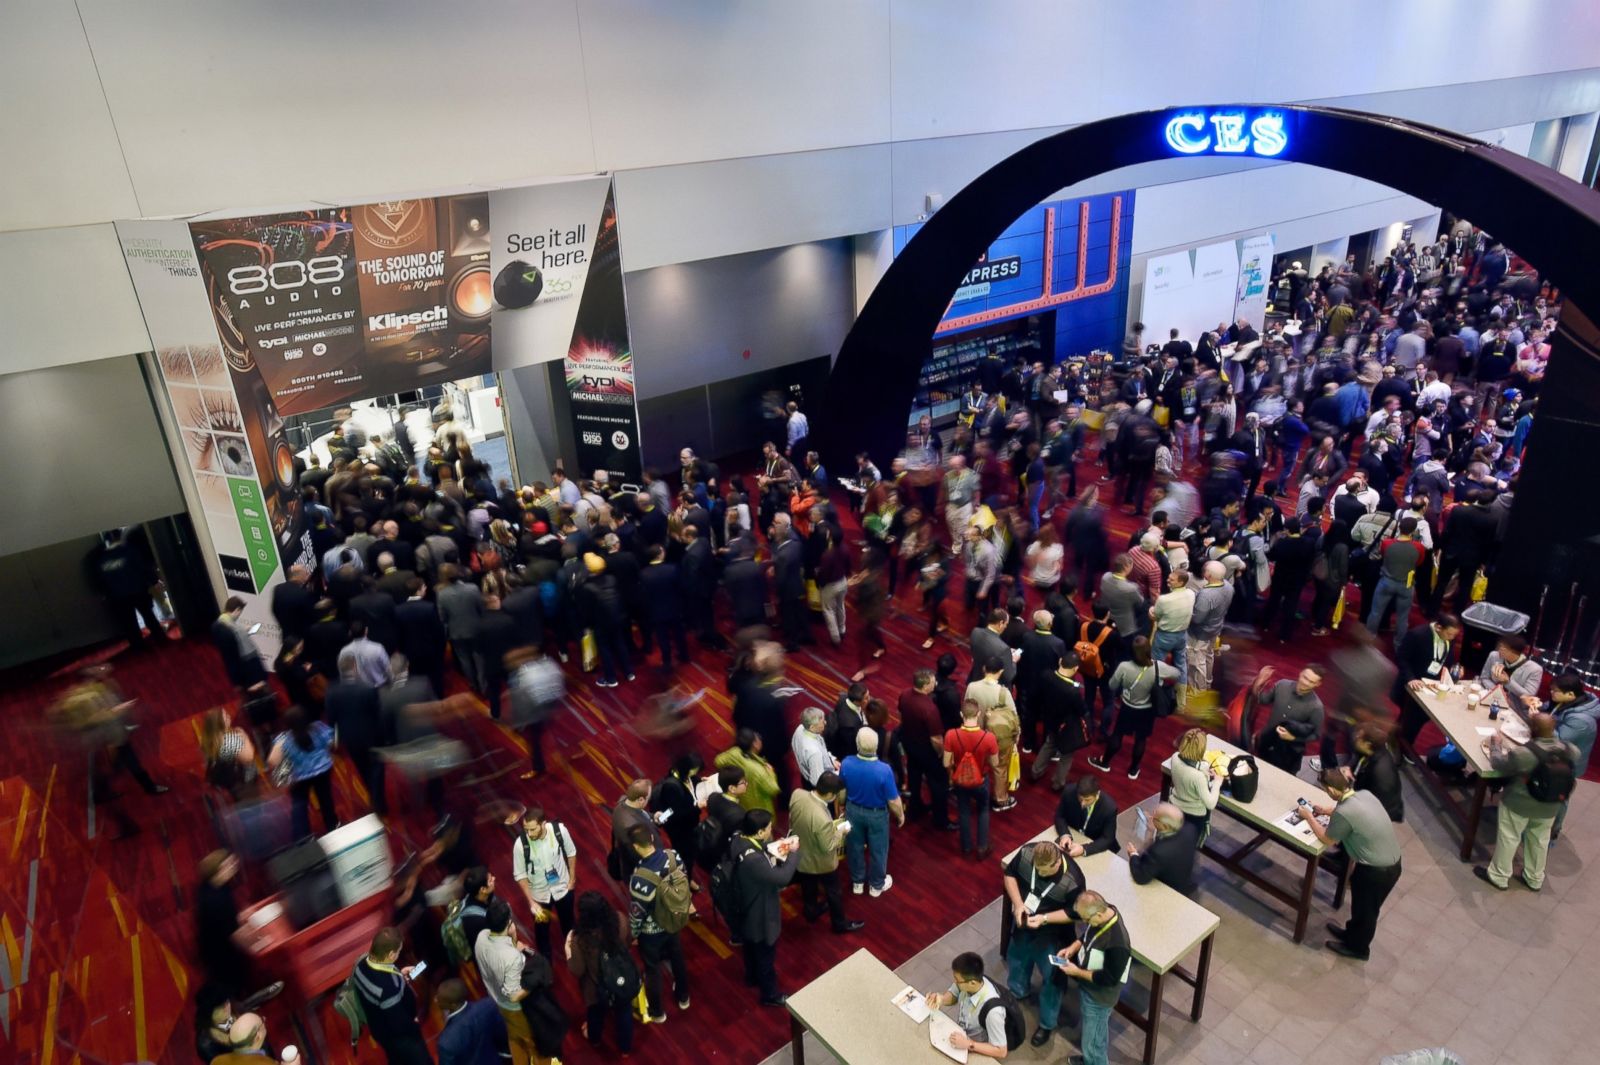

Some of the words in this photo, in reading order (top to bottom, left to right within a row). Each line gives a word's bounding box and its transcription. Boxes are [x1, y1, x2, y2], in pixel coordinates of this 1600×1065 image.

[1165, 112, 1287, 156] CES
[507, 233, 545, 254] See
[549, 228, 562, 248] it
[565, 223, 586, 246] all
[359, 258, 384, 274] THE
[386, 253, 428, 271] SOUND
[429, 250, 445, 264] OF
[541, 249, 587, 270] here.
[167, 267, 198, 277] THINGS
[227, 255, 345, 295] 808
[373, 262, 445, 286] TOMORROW
[961, 261, 1018, 285] XPRESS
[413, 280, 425, 289] 70
[240, 286, 342, 309] AUDIO
[254, 323, 272, 333] LIVE
[273, 311, 343, 330] PERFORMANCES
[344, 310, 356, 319] BY
[288, 308, 323, 318] FEATURING
[368, 304, 448, 332] Klipsch
